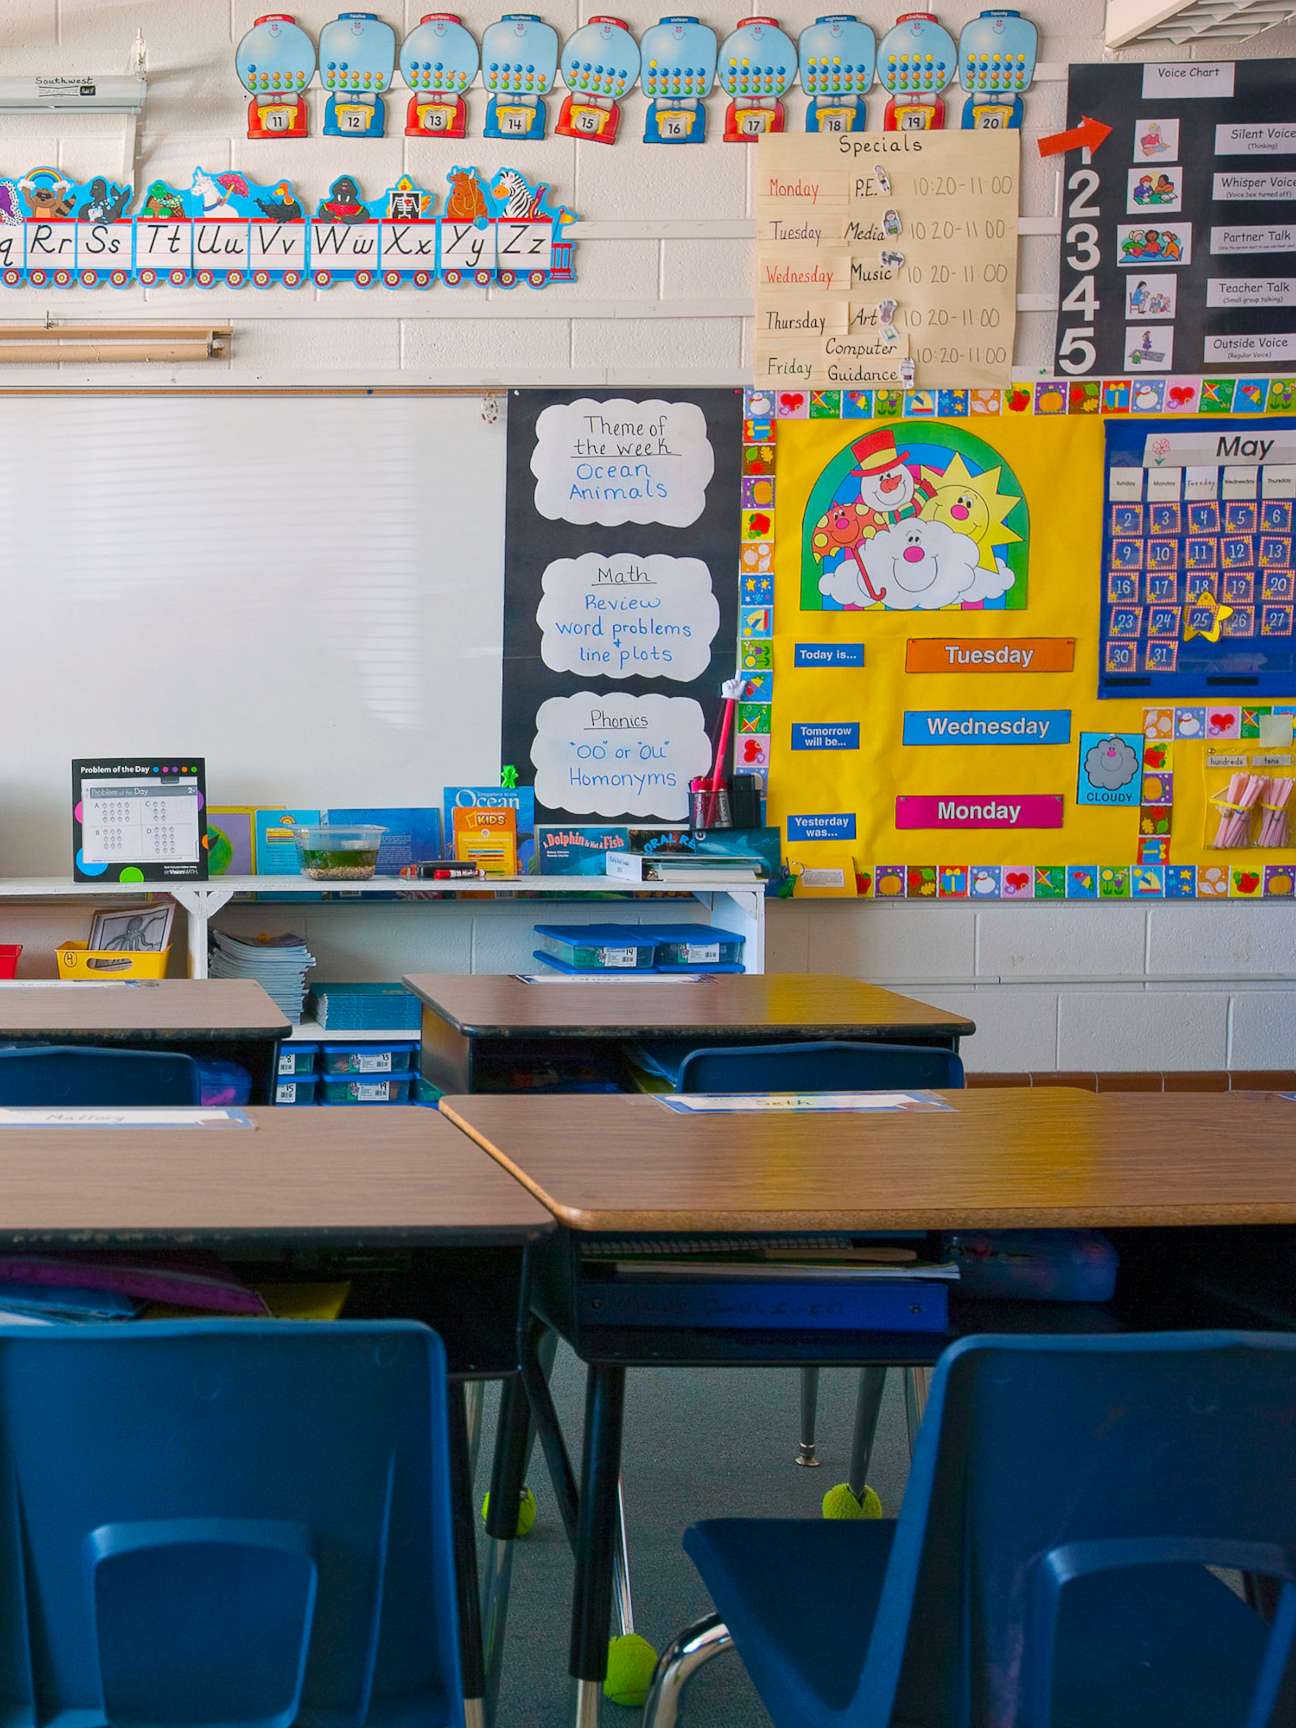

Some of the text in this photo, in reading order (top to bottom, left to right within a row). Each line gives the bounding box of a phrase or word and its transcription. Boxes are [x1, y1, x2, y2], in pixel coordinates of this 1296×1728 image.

[35, 76, 94, 85] Southwest
[1157, 67, 1221, 78] Voice Chart
[272, 116, 283, 127] 11
[347, 116, 360, 127] 12
[429, 115, 442, 127] 13
[508, 118, 522, 130] 14
[581, 116, 595, 129] 15
[667, 123, 681, 135] 16
[748, 119, 760, 131] 17
[829, 120, 842, 131] 18
[907, 115, 920, 128] 19
[982, 117, 1000, 129] 20
[1231, 128, 1296, 140] Silent Voice
[839, 134, 923, 157] Specials
[769, 179, 878, 204] Monday P.E.
[1221, 177, 1267, 190] Whisper
[1068, 170, 1101, 219] 2
[769, 220, 884, 247] Tuesday Media
[1223, 230, 1291, 242] Partner Talk
[84, 223, 121, 255] Ss
[197, 224, 244, 255] Uu
[314, 224, 374, 255] Ww
[383, 224, 432, 255] Xx
[447, 224, 485, 268] Yy
[501, 224, 546, 255] Zz
[1066, 223, 1101, 272] 3
[766, 264, 892, 289] Wednesday Music
[1219, 282, 1290, 293] Teacher Talk
[1061, 275, 1100, 322] 4
[766, 308, 878, 335] Thursday Art
[824, 337, 897, 361] Computer
[1058, 327, 1097, 375] 5
[1213, 337, 1288, 349] Outside Voice
[767, 357, 813, 381] Friday
[827, 366, 898, 383] Guidance
[583, 415, 669, 437] Theme of
[572, 438, 672, 456] the week
[1215, 435, 1275, 460] May
[576, 463, 652, 481] Ocean
[567, 479, 669, 501] Animals
[1154, 543, 1245, 561] 10 12
[597, 567, 651, 584] Math
[1269, 577, 1287, 592] 20
[584, 593, 663, 611] Review
[1154, 612, 1210, 629] 24 25
[554, 621, 693, 644] word problems
[578, 644, 673, 670] line plots
[799, 649, 858, 662] Today is...
[945, 645, 1034, 669] Tuesday
[1111, 647, 1168, 664] 30 31
[589, 709, 649, 729] Phonics
[800, 726, 853, 738] Tomorrow
[926, 716, 1051, 740] Wednesday
[804, 736, 847, 748] will be...
[614, 745, 632, 760] or
[80, 765, 151, 776] Problem of the Day
[567, 768, 678, 796] Homonyms
[455, 789, 521, 810] Ocean
[1086, 791, 1133, 803] CLOUDY
[476, 815, 506, 825] KIDS
[937, 801, 1023, 824] Monday
[794, 816, 850, 829] Yesterday
[547, 831, 625, 850] Dolphin Fish
[805, 829, 839, 839] was...
